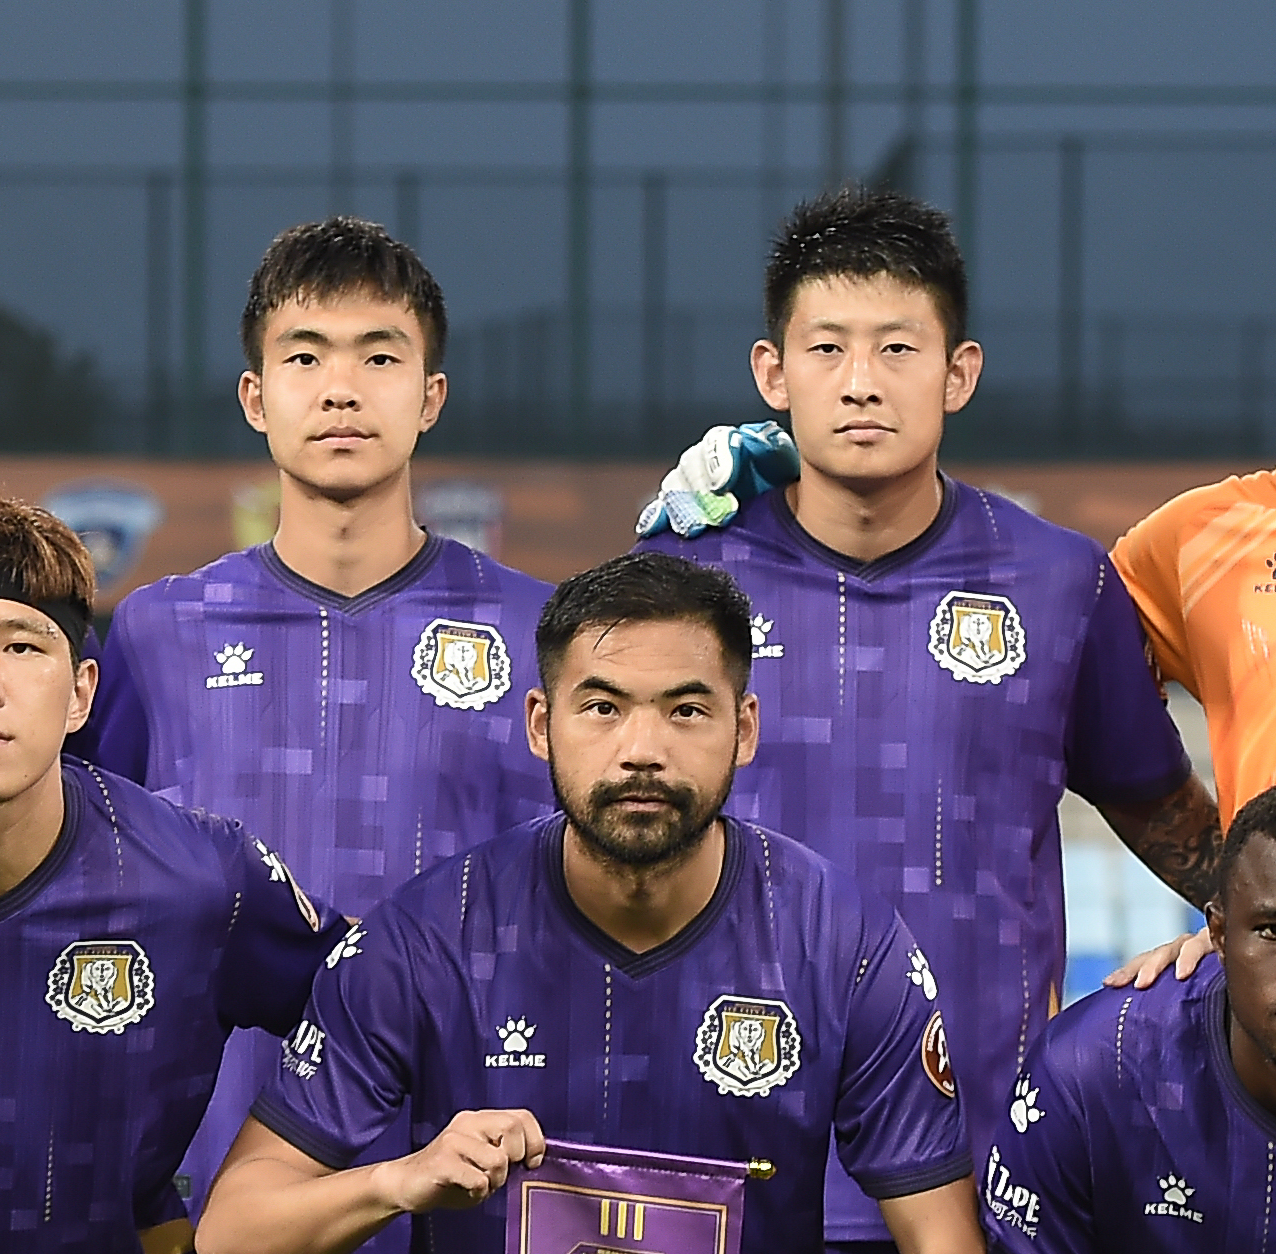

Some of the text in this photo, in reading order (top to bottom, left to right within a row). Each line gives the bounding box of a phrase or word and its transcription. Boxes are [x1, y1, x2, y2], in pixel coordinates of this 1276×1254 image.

[206, 672, 264, 689] KELME
[485, 1054, 546, 1067] KELME
[1144, 1203, 1203, 1223] KELME
